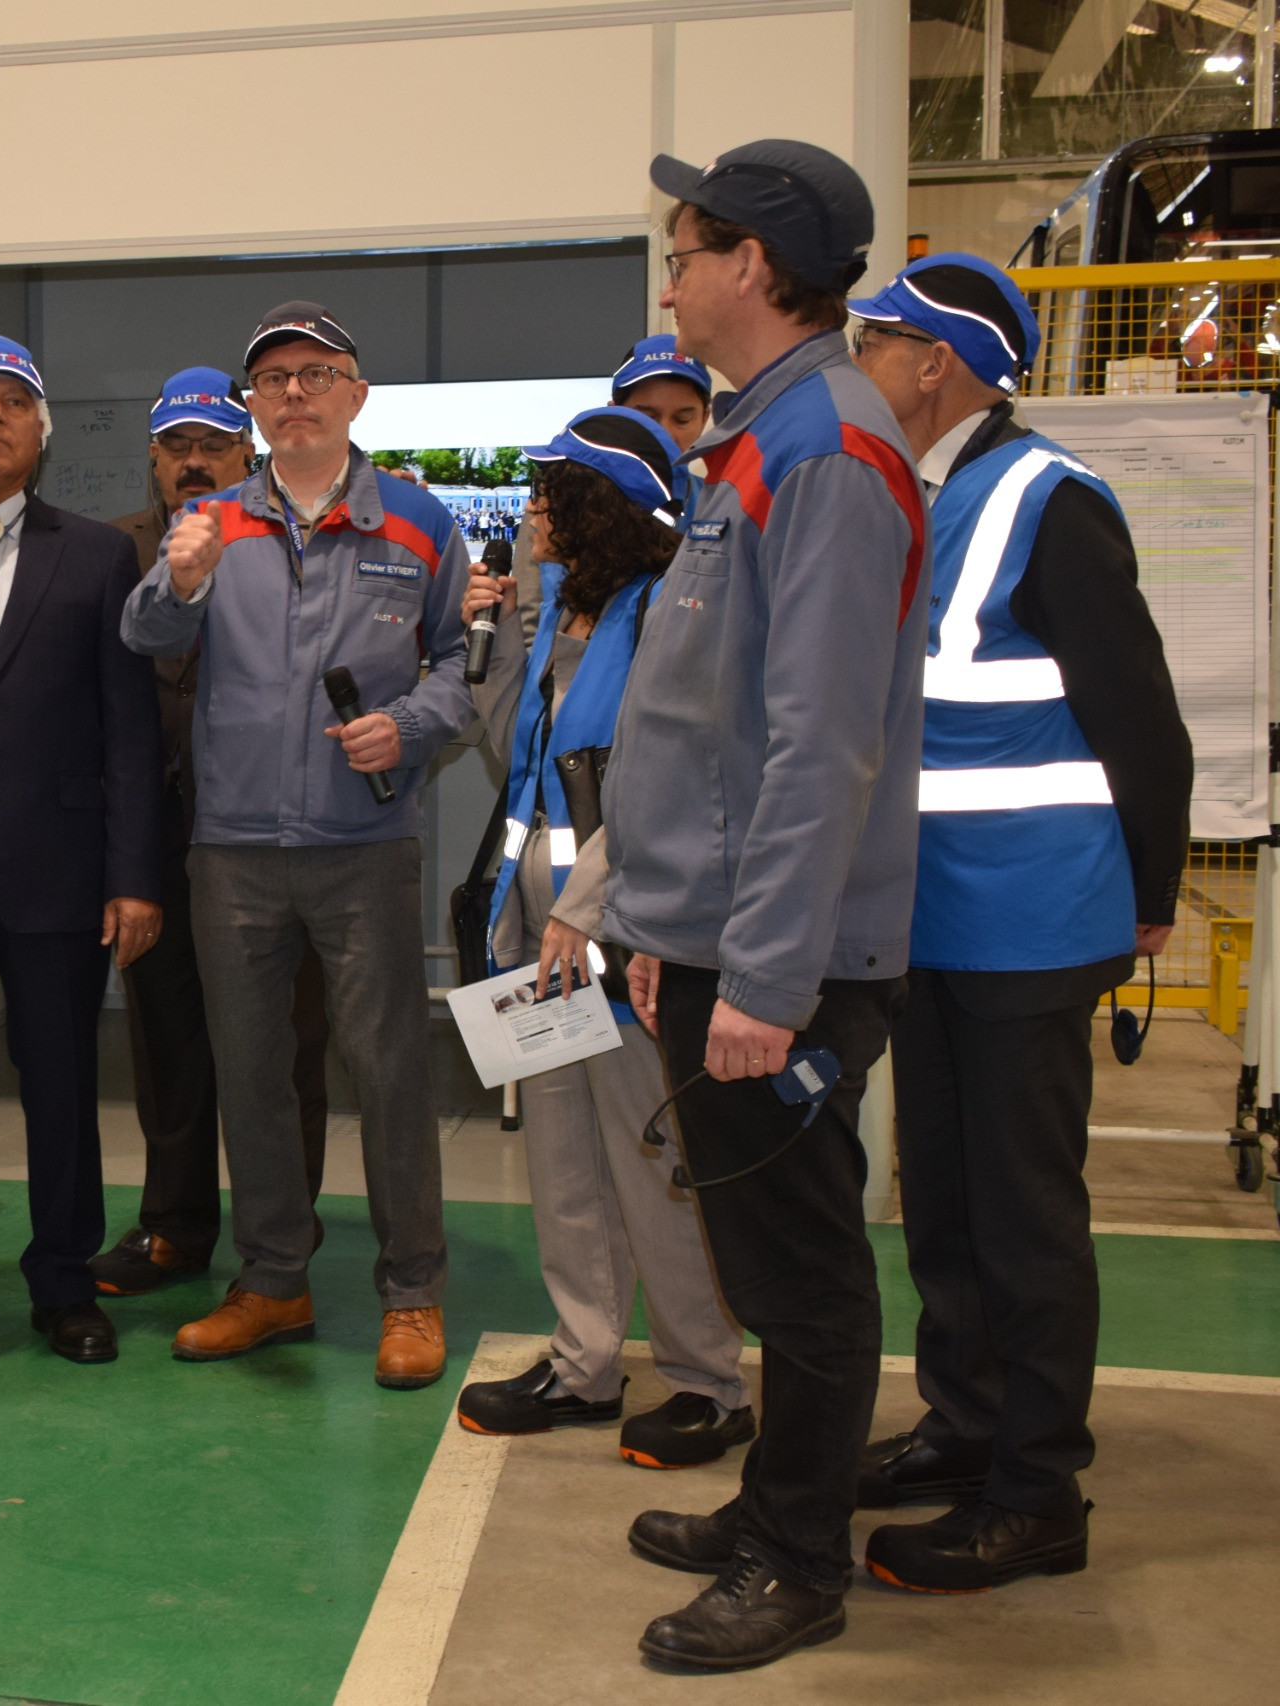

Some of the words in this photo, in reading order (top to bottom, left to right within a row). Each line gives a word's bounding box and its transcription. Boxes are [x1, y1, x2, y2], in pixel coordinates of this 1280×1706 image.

[643, 352, 694, 365] ALSTOM
[169, 393, 221, 406] ALSTOM
[290, 523, 303, 551] ALSTOM
[360, 562, 386, 572] Olivier
[373, 612, 404, 624] ALSTOM
